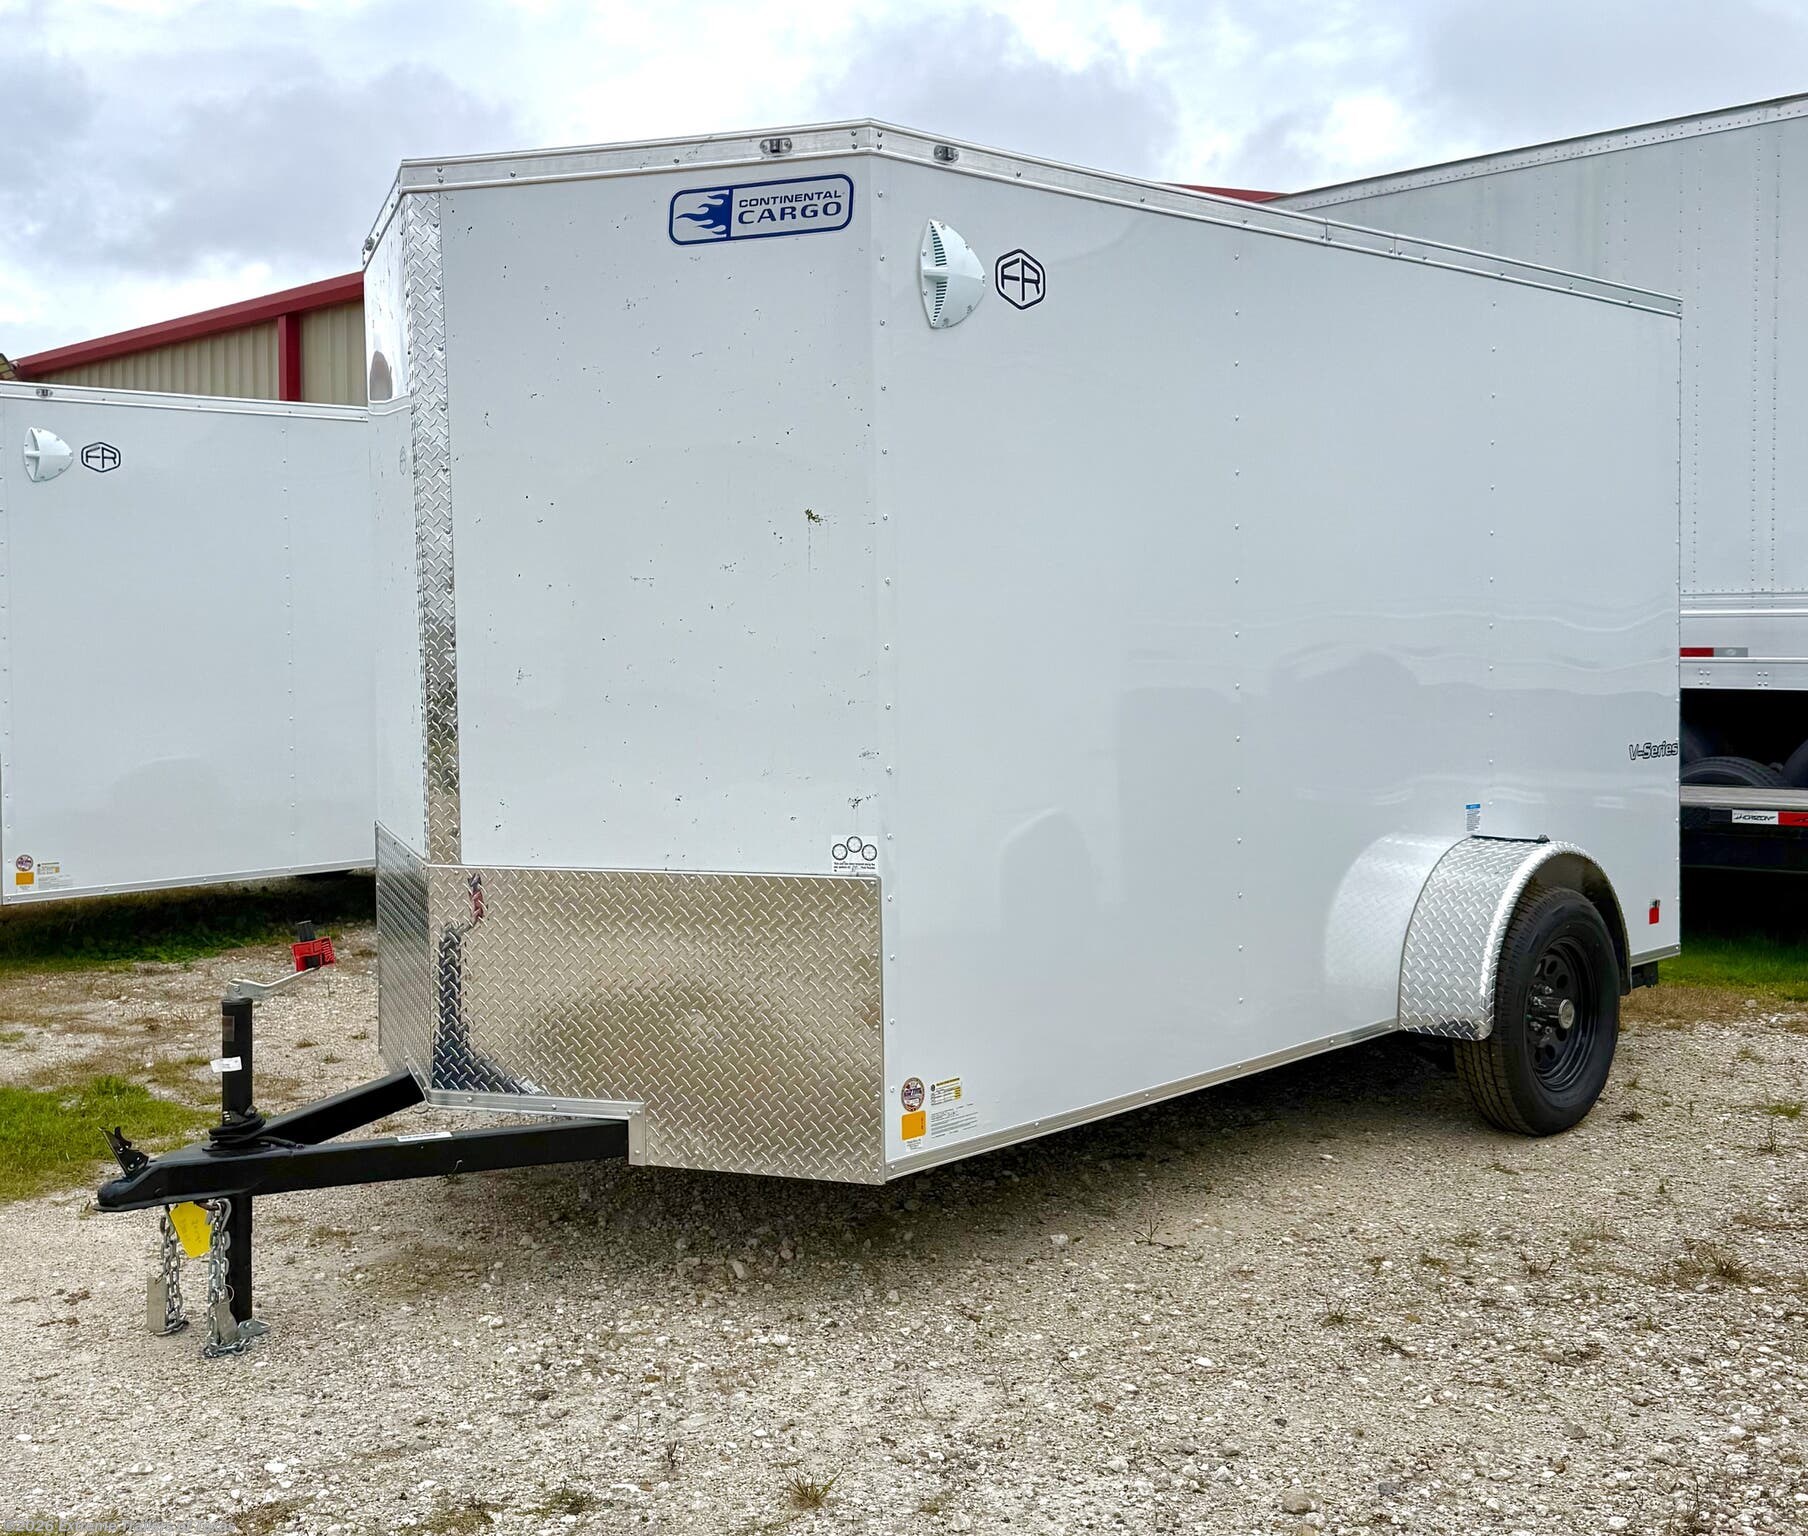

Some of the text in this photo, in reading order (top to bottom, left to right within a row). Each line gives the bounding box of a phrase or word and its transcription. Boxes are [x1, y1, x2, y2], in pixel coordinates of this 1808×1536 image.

[739, 190, 842, 208] CONTINENTAL
[738, 201, 842, 225] CARGO
[1001, 257, 1041, 301] FR
[1628, 741, 1679, 760] V-Series
